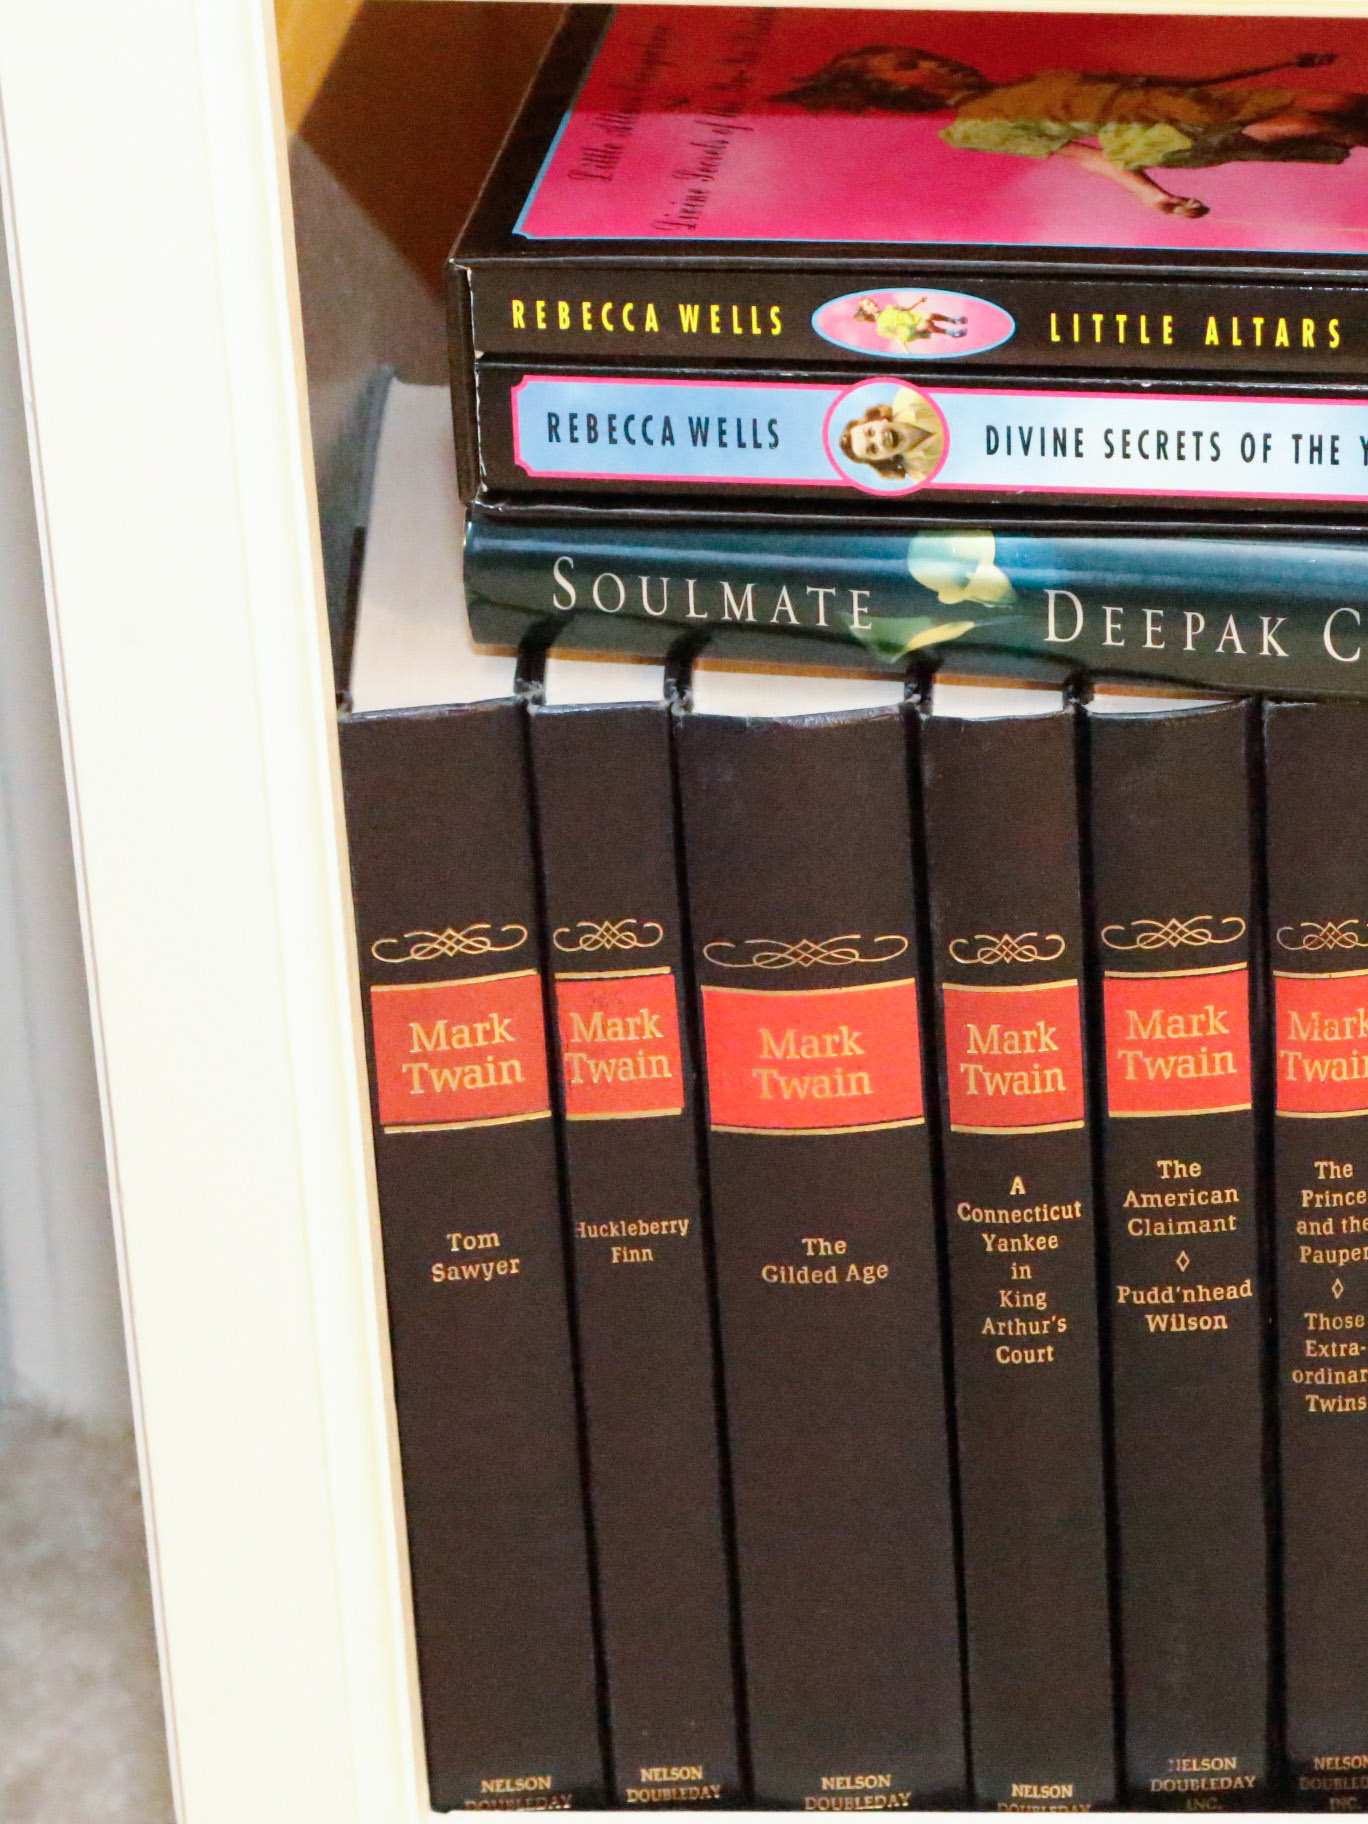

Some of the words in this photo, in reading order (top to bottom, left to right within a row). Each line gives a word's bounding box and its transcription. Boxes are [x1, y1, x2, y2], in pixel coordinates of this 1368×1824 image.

[511, 299, 660, 332] REBECCA
[680, 304, 783, 336] WELLS
[1050, 312, 1176, 345] LITTLE
[1205, 316, 1342, 349] ALTARS
[547, 411, 676, 447] REBECCA
[688, 416, 781, 450] WELLS
[985, 424, 1085, 459] DIVINE
[1103, 428, 1223, 463] SECRETS
[1240, 431, 1274, 464] OF
[1292, 433, 1342, 467] THE
[551, 556, 873, 630] SOULMATE
[1043, 588, 1290, 657] DEEPAK
[408, 1012, 517, 1054] Mark
[569, 1008, 664, 1044] Mark
[1124, 1005, 1230, 1041] Mark
[758, 1025, 865, 1060] Mark
[965, 1020, 1059, 1055] Mark
[564, 1050, 673, 1084] Twain
[1117, 1046, 1237, 1081] Twain
[402, 1056, 525, 1095] Twain
[752, 1064, 874, 1099] Twain
[959, 1062, 1067, 1097] Twain
[1156, 1159, 1202, 1180] The
[1314, 1160, 1354, 1180] The
[1009, 1175, 1026, 1195] A
[1122, 1187, 1240, 1208] American
[1301, 1188, 1368, 1208] Prince
[956, 1201, 1083, 1224] Connecticut
[1127, 1214, 1237, 1237] Claimant
[1296, 1217, 1334, 1236] and
[446, 1229, 501, 1253] Tom
[801, 1237, 848, 1256] The
[981, 1232, 1059, 1253] Yankee
[610, 1246, 654, 1264] Finn
[431, 1256, 521, 1283] Sawyer
[760, 1263, 838, 1286] Gilded
[844, 1261, 889, 1285] Age
[1011, 1262, 1032, 1280] in
[999, 1289, 1048, 1311] King
[1116, 1279, 1254, 1304] Pudd'nhead
[981, 1315, 1068, 1336] Arthur's
[1145, 1312, 1228, 1333] Wilson
[1304, 1312, 1366, 1331] Those
[995, 1345, 1054, 1365] Court
[1304, 1339, 1368, 1358] Extra-
[1305, 1394, 1368, 1413] Twins
[640, 1765, 703, 1783] NELSON
[1168, 1756, 1238, 1773] NELSON
[480, 1776, 553, 1793] NELSON
[820, 1773, 892, 1791] NELSON
[1010, 1782, 1074, 1799] NELSON
[1150, 1775, 1256, 1793] DOUBLEDAY
[626, 1784, 722, 1804] DOUBLEDAY
[804, 1791, 913, 1812] DOUBLEDAY
